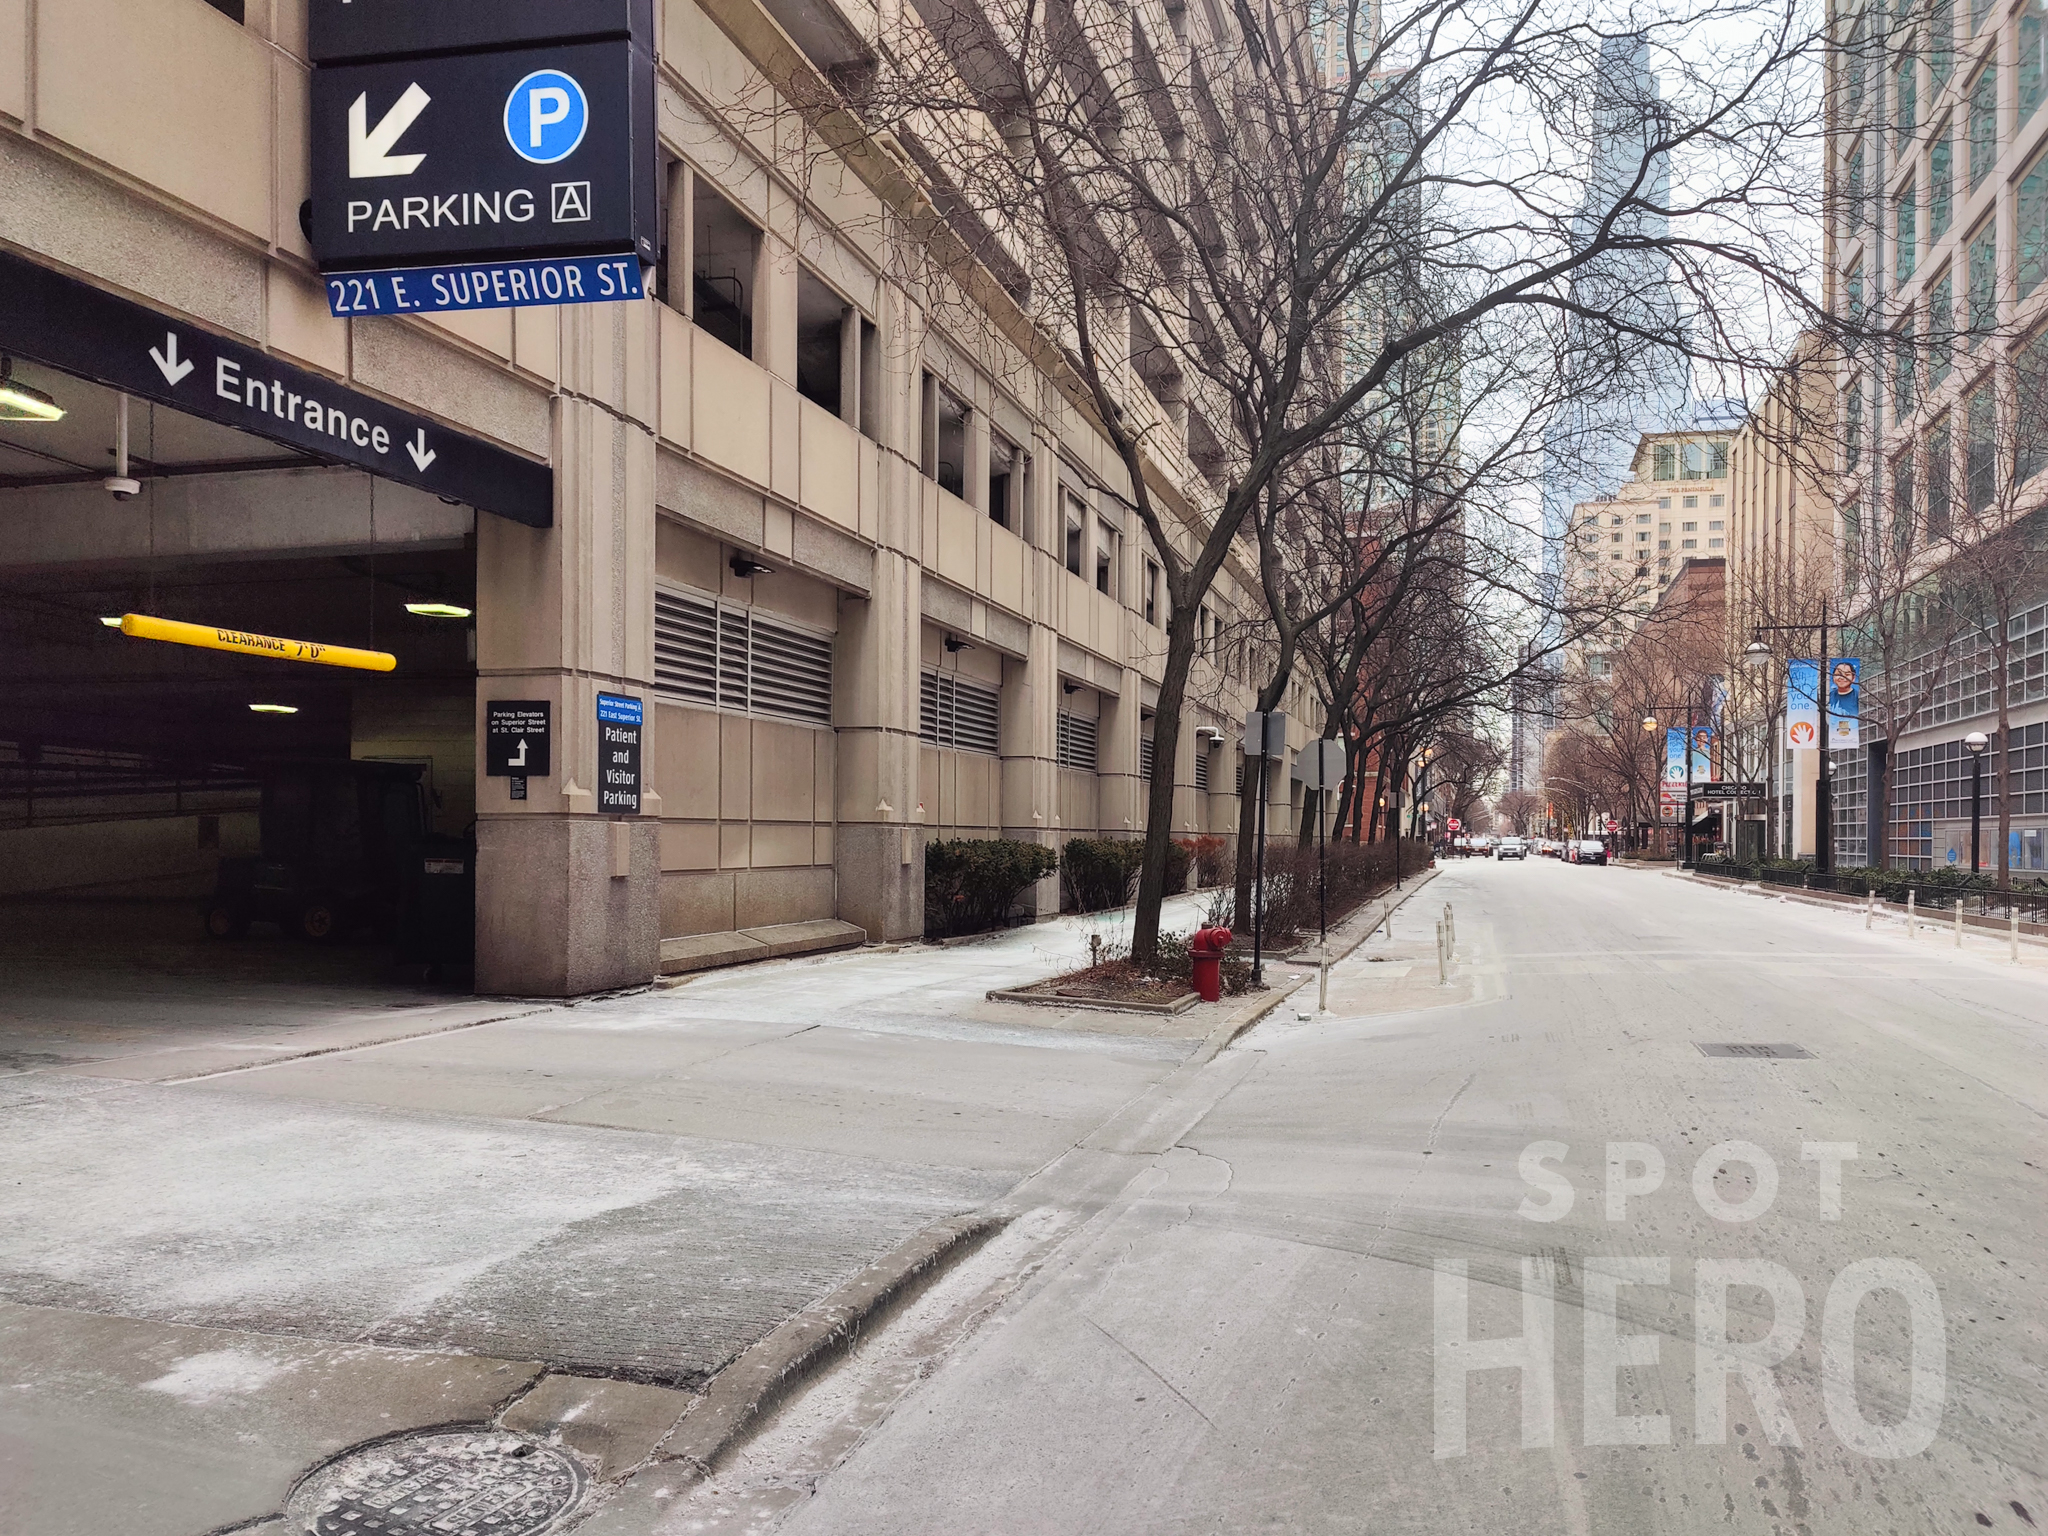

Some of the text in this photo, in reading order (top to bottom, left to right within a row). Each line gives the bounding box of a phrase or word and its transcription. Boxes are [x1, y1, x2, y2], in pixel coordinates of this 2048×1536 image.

[529, 87, 570, 148] P
[347, 185, 588, 233] PARKING A
[331, 262, 638, 312] 221 E. SUPERIOR ST.
[216, 356, 390, 455] Entrance
[217, 629, 286, 652] CLEARANCE
[599, 698, 614, 706] Superior
[614, 700, 625, 709] Street
[625, 702, 637, 712] Parking
[1790, 702, 1812, 710] one.
[493, 711, 515, 719] Parking
[600, 709, 608, 717] 221
[608, 711, 618, 719] East
[618, 712, 636, 722] Superior
[605, 727, 637, 744] Patient
[612, 749, 629, 764] and
[606, 769, 635, 785] Visitor
[603, 790, 637, 809] Parking
